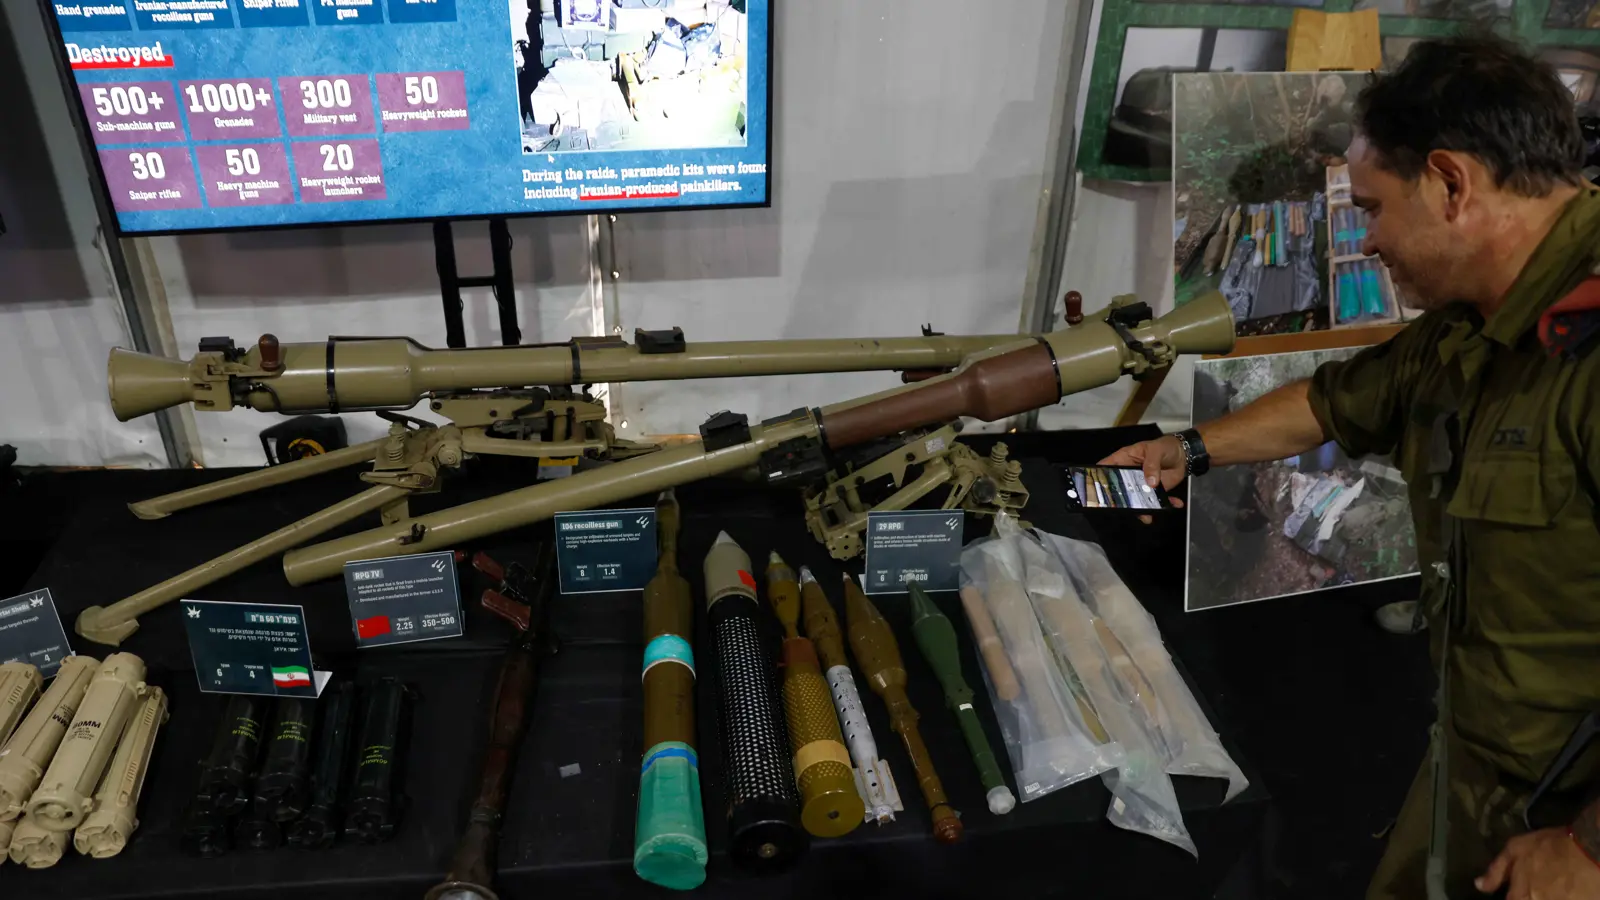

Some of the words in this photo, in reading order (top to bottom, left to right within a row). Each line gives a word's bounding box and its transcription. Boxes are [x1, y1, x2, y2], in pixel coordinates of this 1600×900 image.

[55, 4, 81, 16] Hand
[83, 4, 126, 17] grenades
[134, 0, 228, 10] Iranian-manufactured
[151, 11, 193, 22] recoilless
[194, 12, 214, 23] guns
[336, 9, 358, 20] guns
[65, 42, 165, 66] Destroyed
[300, 78, 352, 109] 300
[404, 76, 438, 104] 50
[92, 86, 164, 116] 500+
[185, 82, 271, 114] 1000+
[304, 114, 337, 126] Military
[338, 113, 357, 123] vest
[382, 109, 435, 122] Heavyweight
[436, 108, 468, 118] rockets
[97, 119, 152, 132] Sub-machine
[154, 120, 176, 132] guns
[214, 116, 254, 128] Grenades
[226, 148, 260, 176] 50
[320, 144, 354, 171] 20
[129, 152, 166, 180] 30
[522, 168, 562, 184] During
[565, 168, 584, 180] the
[586, 166, 618, 180] raids,
[620, 164, 680, 181] paramedic
[683, 163, 704, 176] kits
[706, 164, 736, 175] were
[217, 181, 244, 194] Heavy
[244, 179, 280, 190] machine
[302, 176, 354, 188] Heavyweight
[355, 174, 381, 186] rocket
[129, 190, 157, 202] Sniper
[158, 188, 182, 200] rifles
[239, 190, 260, 200] guns
[323, 186, 363, 196] launchers
[524, 186, 578, 200] including
[580, 182, 678, 198] Iranian-produced
[680, 180, 742, 194] painkillers.
[606, 521, 618, 530] gun
[354, 571, 370, 580] RPG
[266, 614, 275, 623] 60
[396, 622, 413, 630] 2.25
[216, 668, 223, 677] 6
[250, 670, 255, 678] 4
